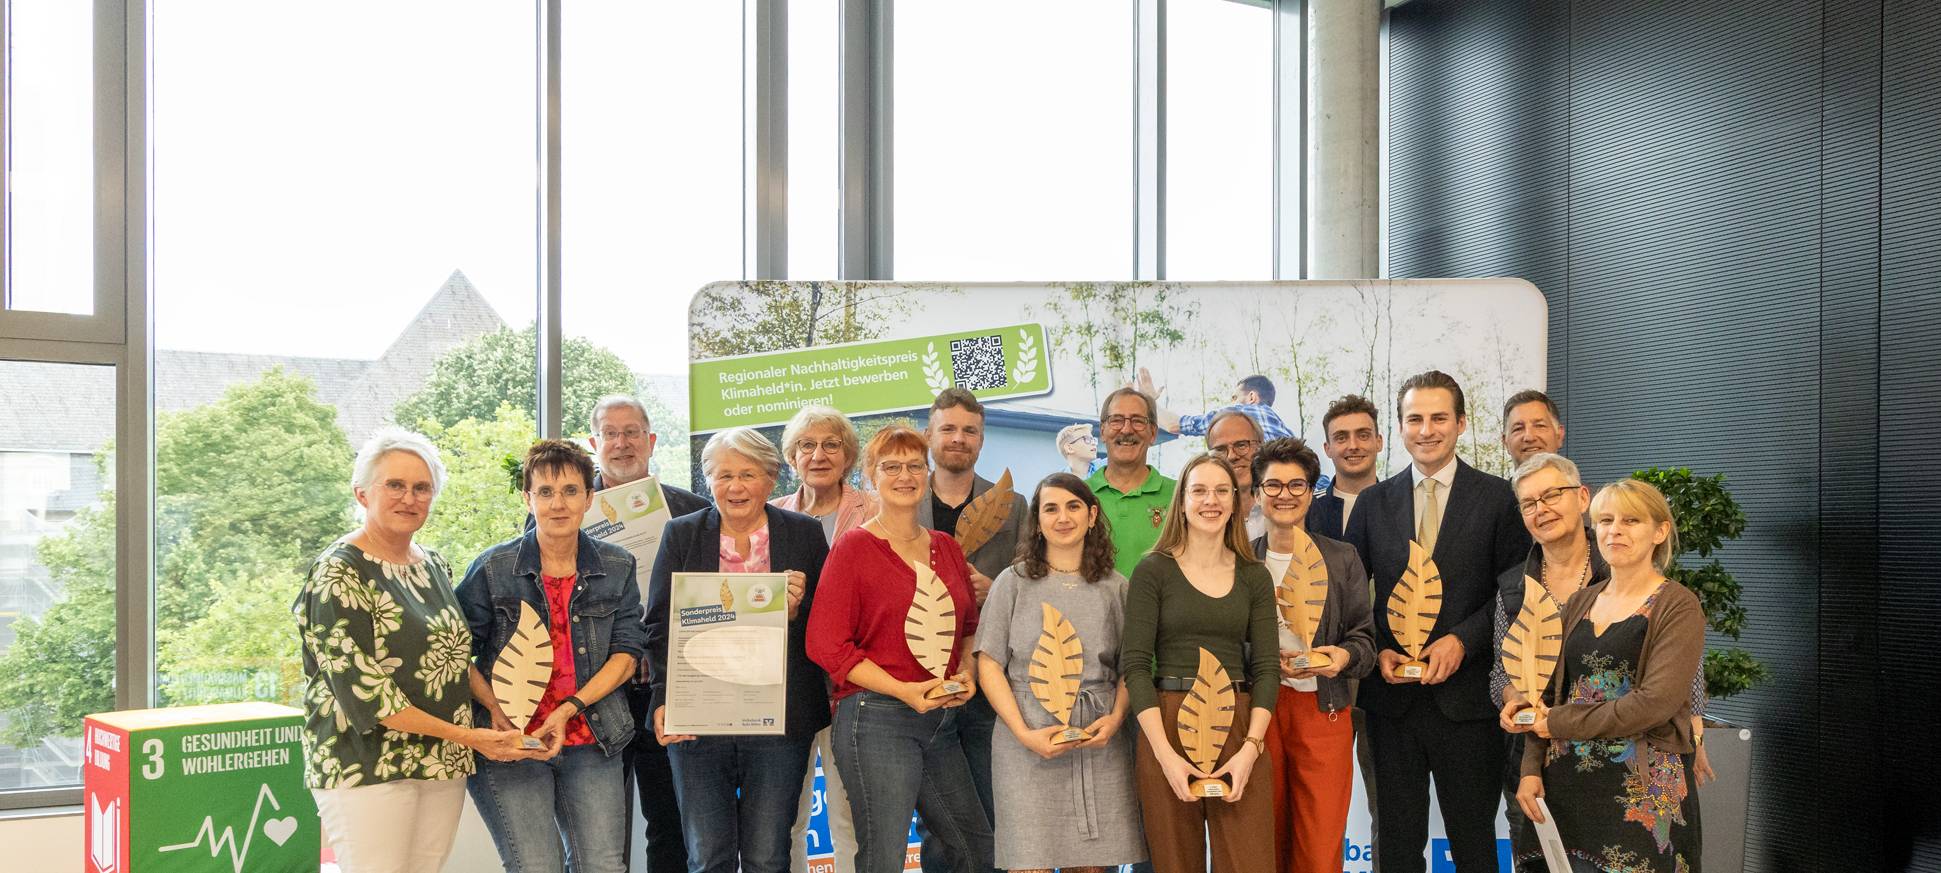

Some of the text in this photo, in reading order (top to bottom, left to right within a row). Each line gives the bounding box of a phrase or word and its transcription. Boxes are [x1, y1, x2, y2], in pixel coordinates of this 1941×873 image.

[719, 350, 918, 384] Regionaler Nachhaltigkeitspreis
[809, 378, 840, 390] Jetzt
[842, 369, 908, 386] bewerben
[723, 394, 833, 416] oder nominieren!
[585, 521, 609, 535] derpreis
[681, 606, 722, 617] Sonderpreis
[681, 613, 735, 625] Klimaheld 2024
[85, 726, 92, 764] 4
[181, 725, 304, 753] GESUNDHEIT UND
[142, 738, 165, 780] 3
[182, 748, 290, 776] WOHLERGEHEN
[1345, 838, 1372, 861] ba
